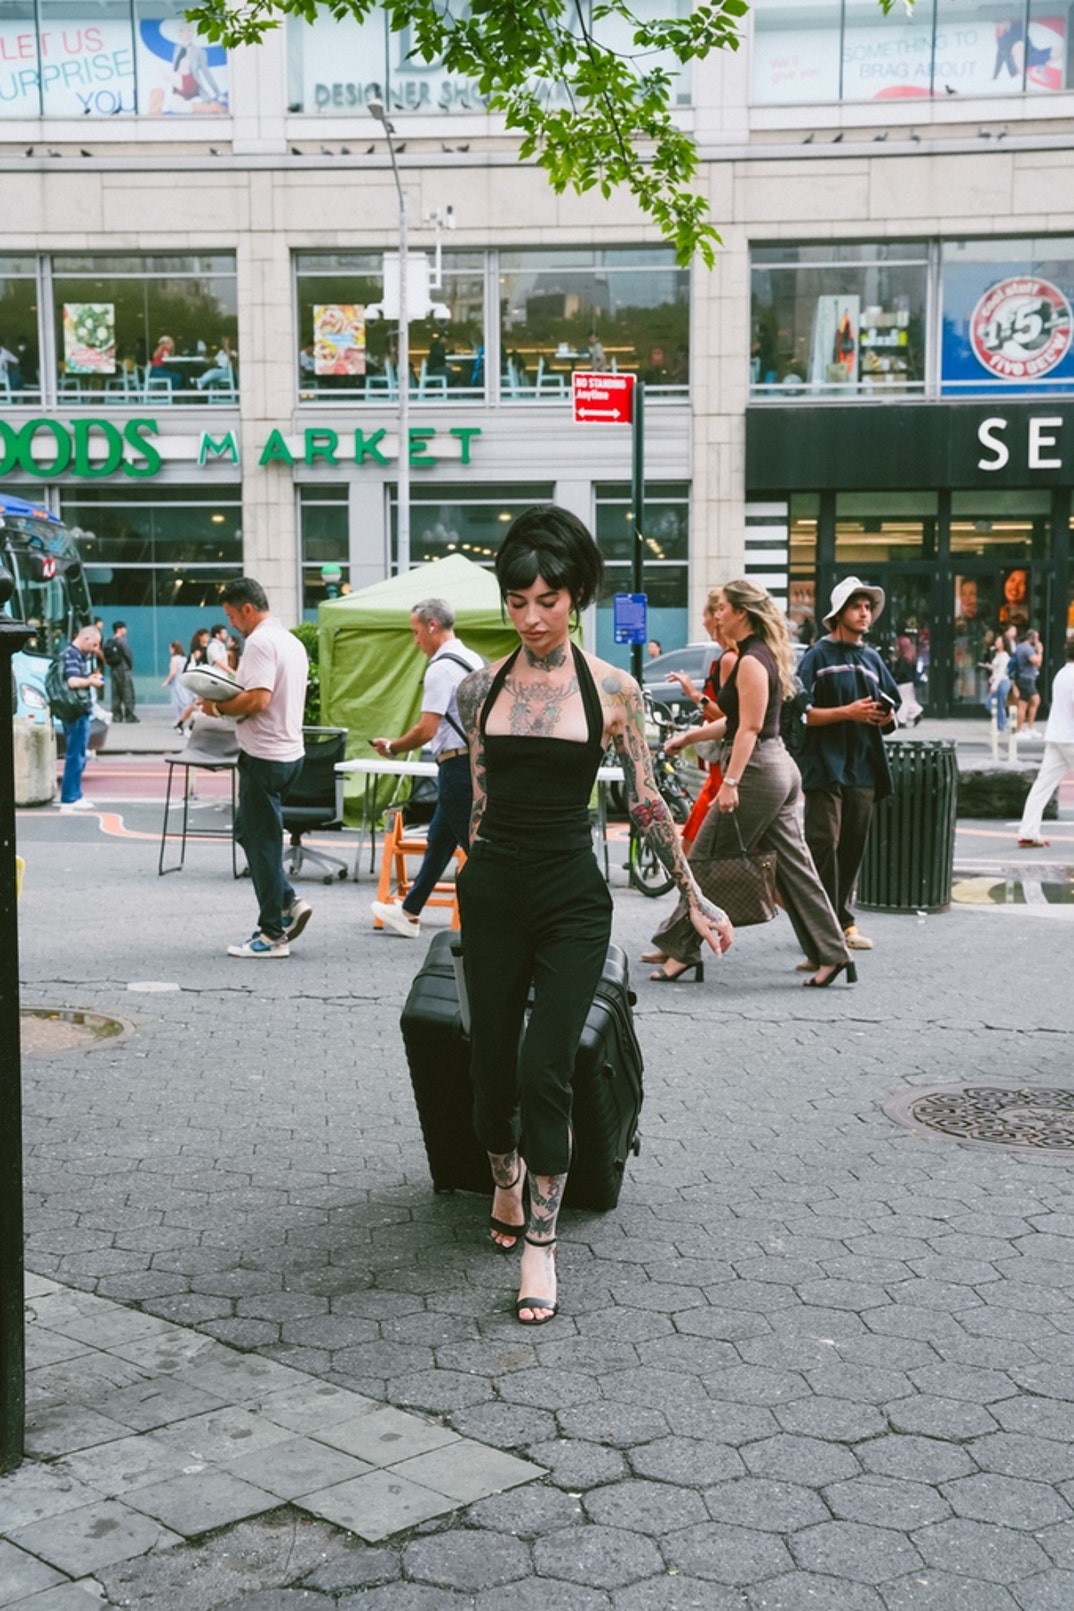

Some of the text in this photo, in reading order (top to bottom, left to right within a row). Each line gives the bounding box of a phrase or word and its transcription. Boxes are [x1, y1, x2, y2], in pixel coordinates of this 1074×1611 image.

[64, 28, 103, 54] US
[843, 30, 978, 62] SOMETHING TO
[859, 60, 977, 79] BRAG ABOUT
[76, 89, 137, 114] YOU
[575, 378, 588, 389] NO
[977, 416, 1064, 471] SE
